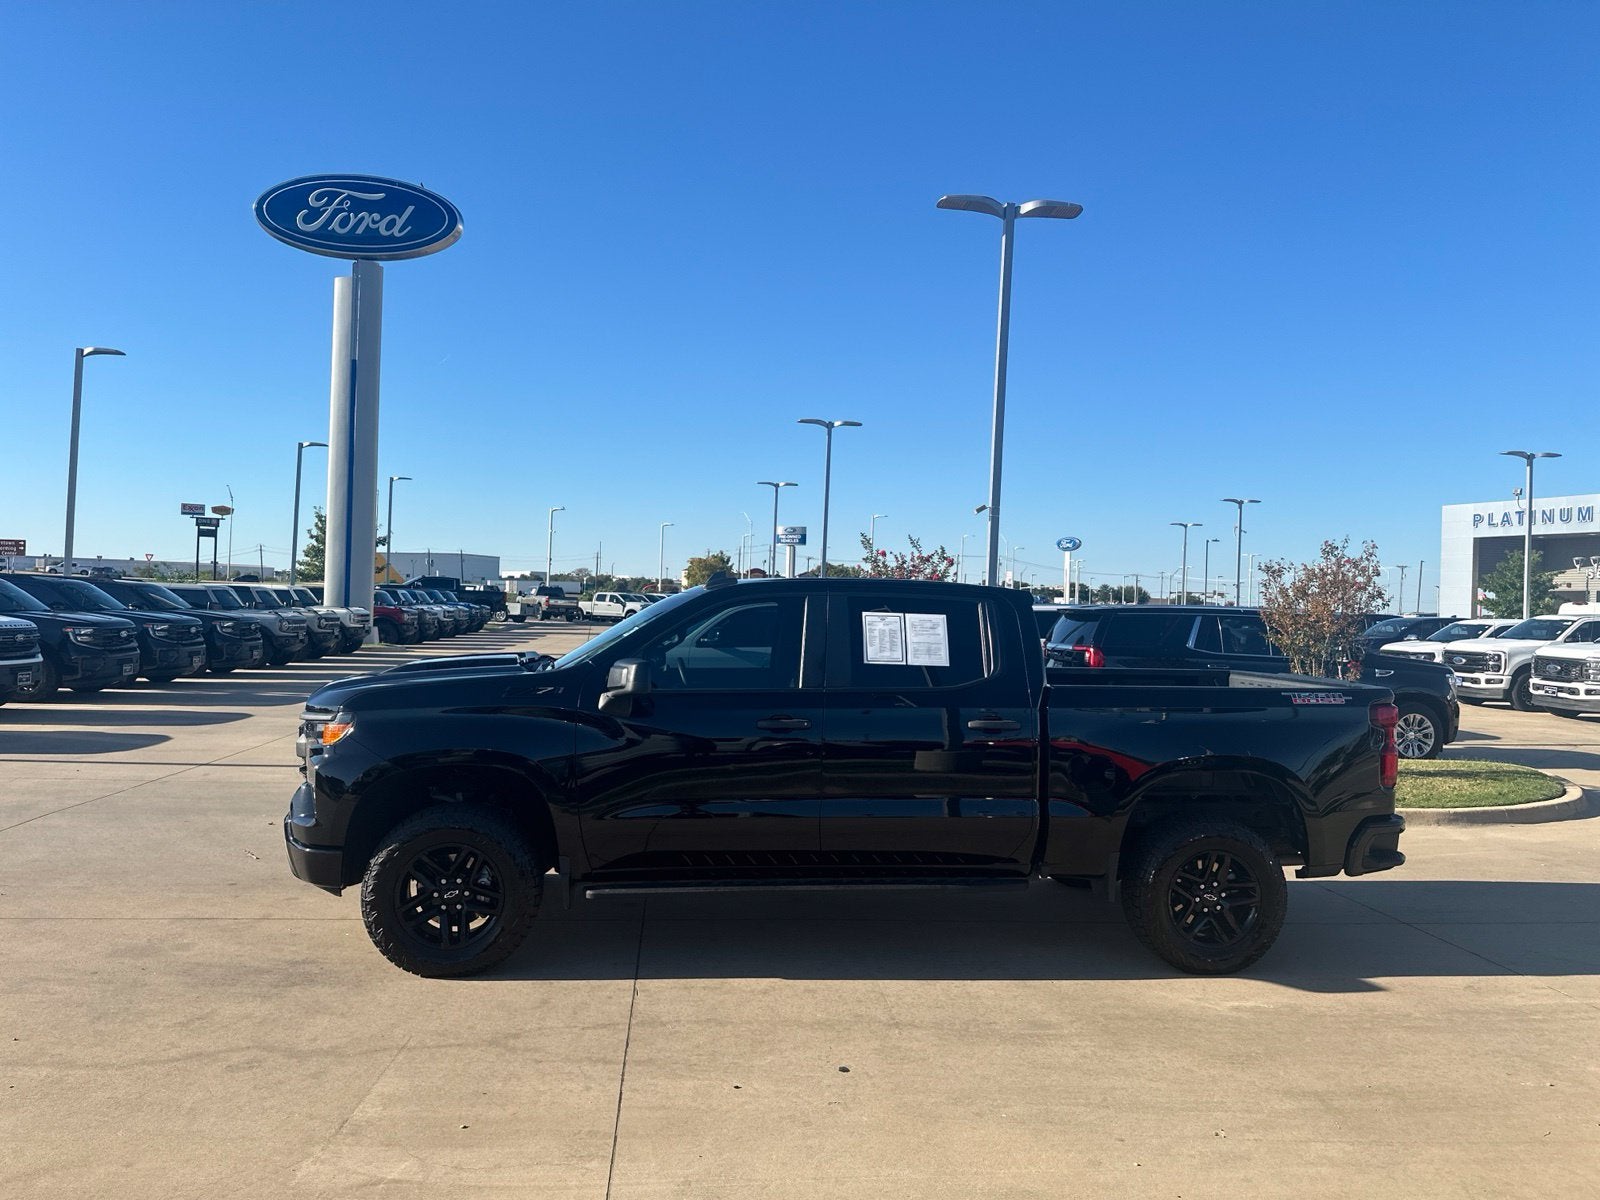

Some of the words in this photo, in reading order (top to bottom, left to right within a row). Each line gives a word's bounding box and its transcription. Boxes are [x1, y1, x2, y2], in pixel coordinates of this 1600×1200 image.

[296, 187, 415, 237] Ford
[183, 504, 204, 512] Exxon
[1473, 505, 1594, 528] PLATINUM
